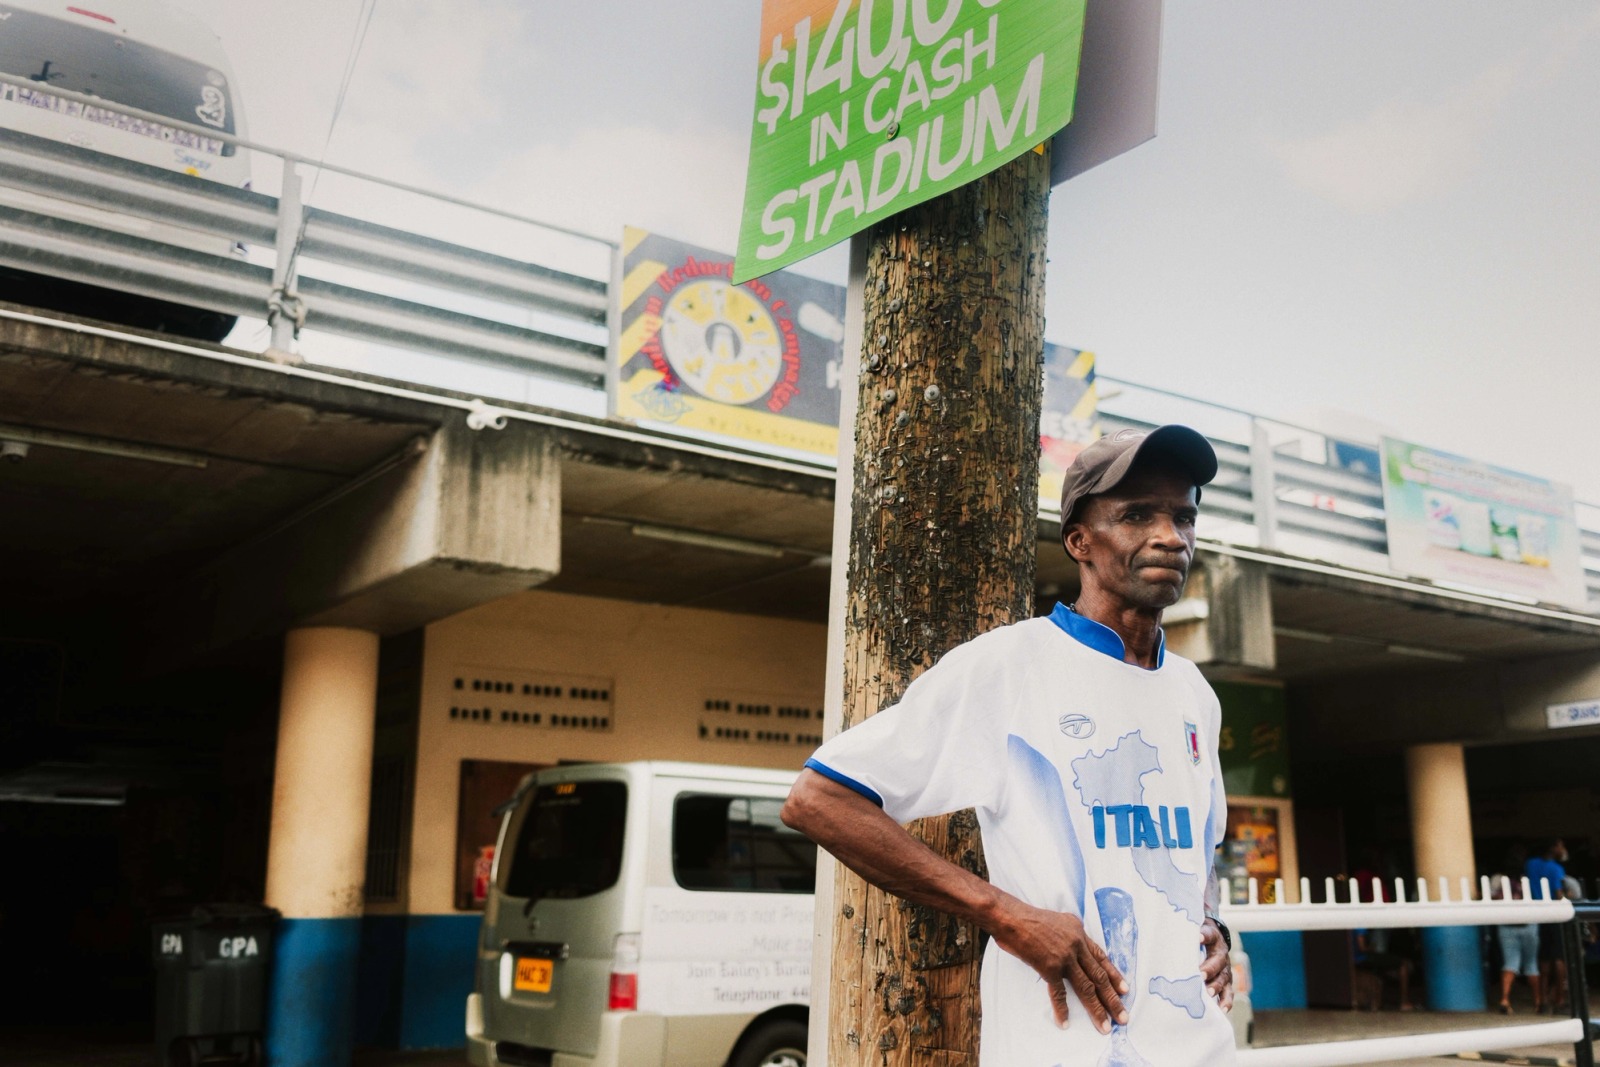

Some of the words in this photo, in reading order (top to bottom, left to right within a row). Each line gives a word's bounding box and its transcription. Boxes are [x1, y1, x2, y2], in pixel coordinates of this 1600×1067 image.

[755, 52, 1045, 260] STADIUM
[809, 100, 850, 167] IN
[864, 13, 998, 134] CASH
[1092, 803, 1194, 850] ITALI
